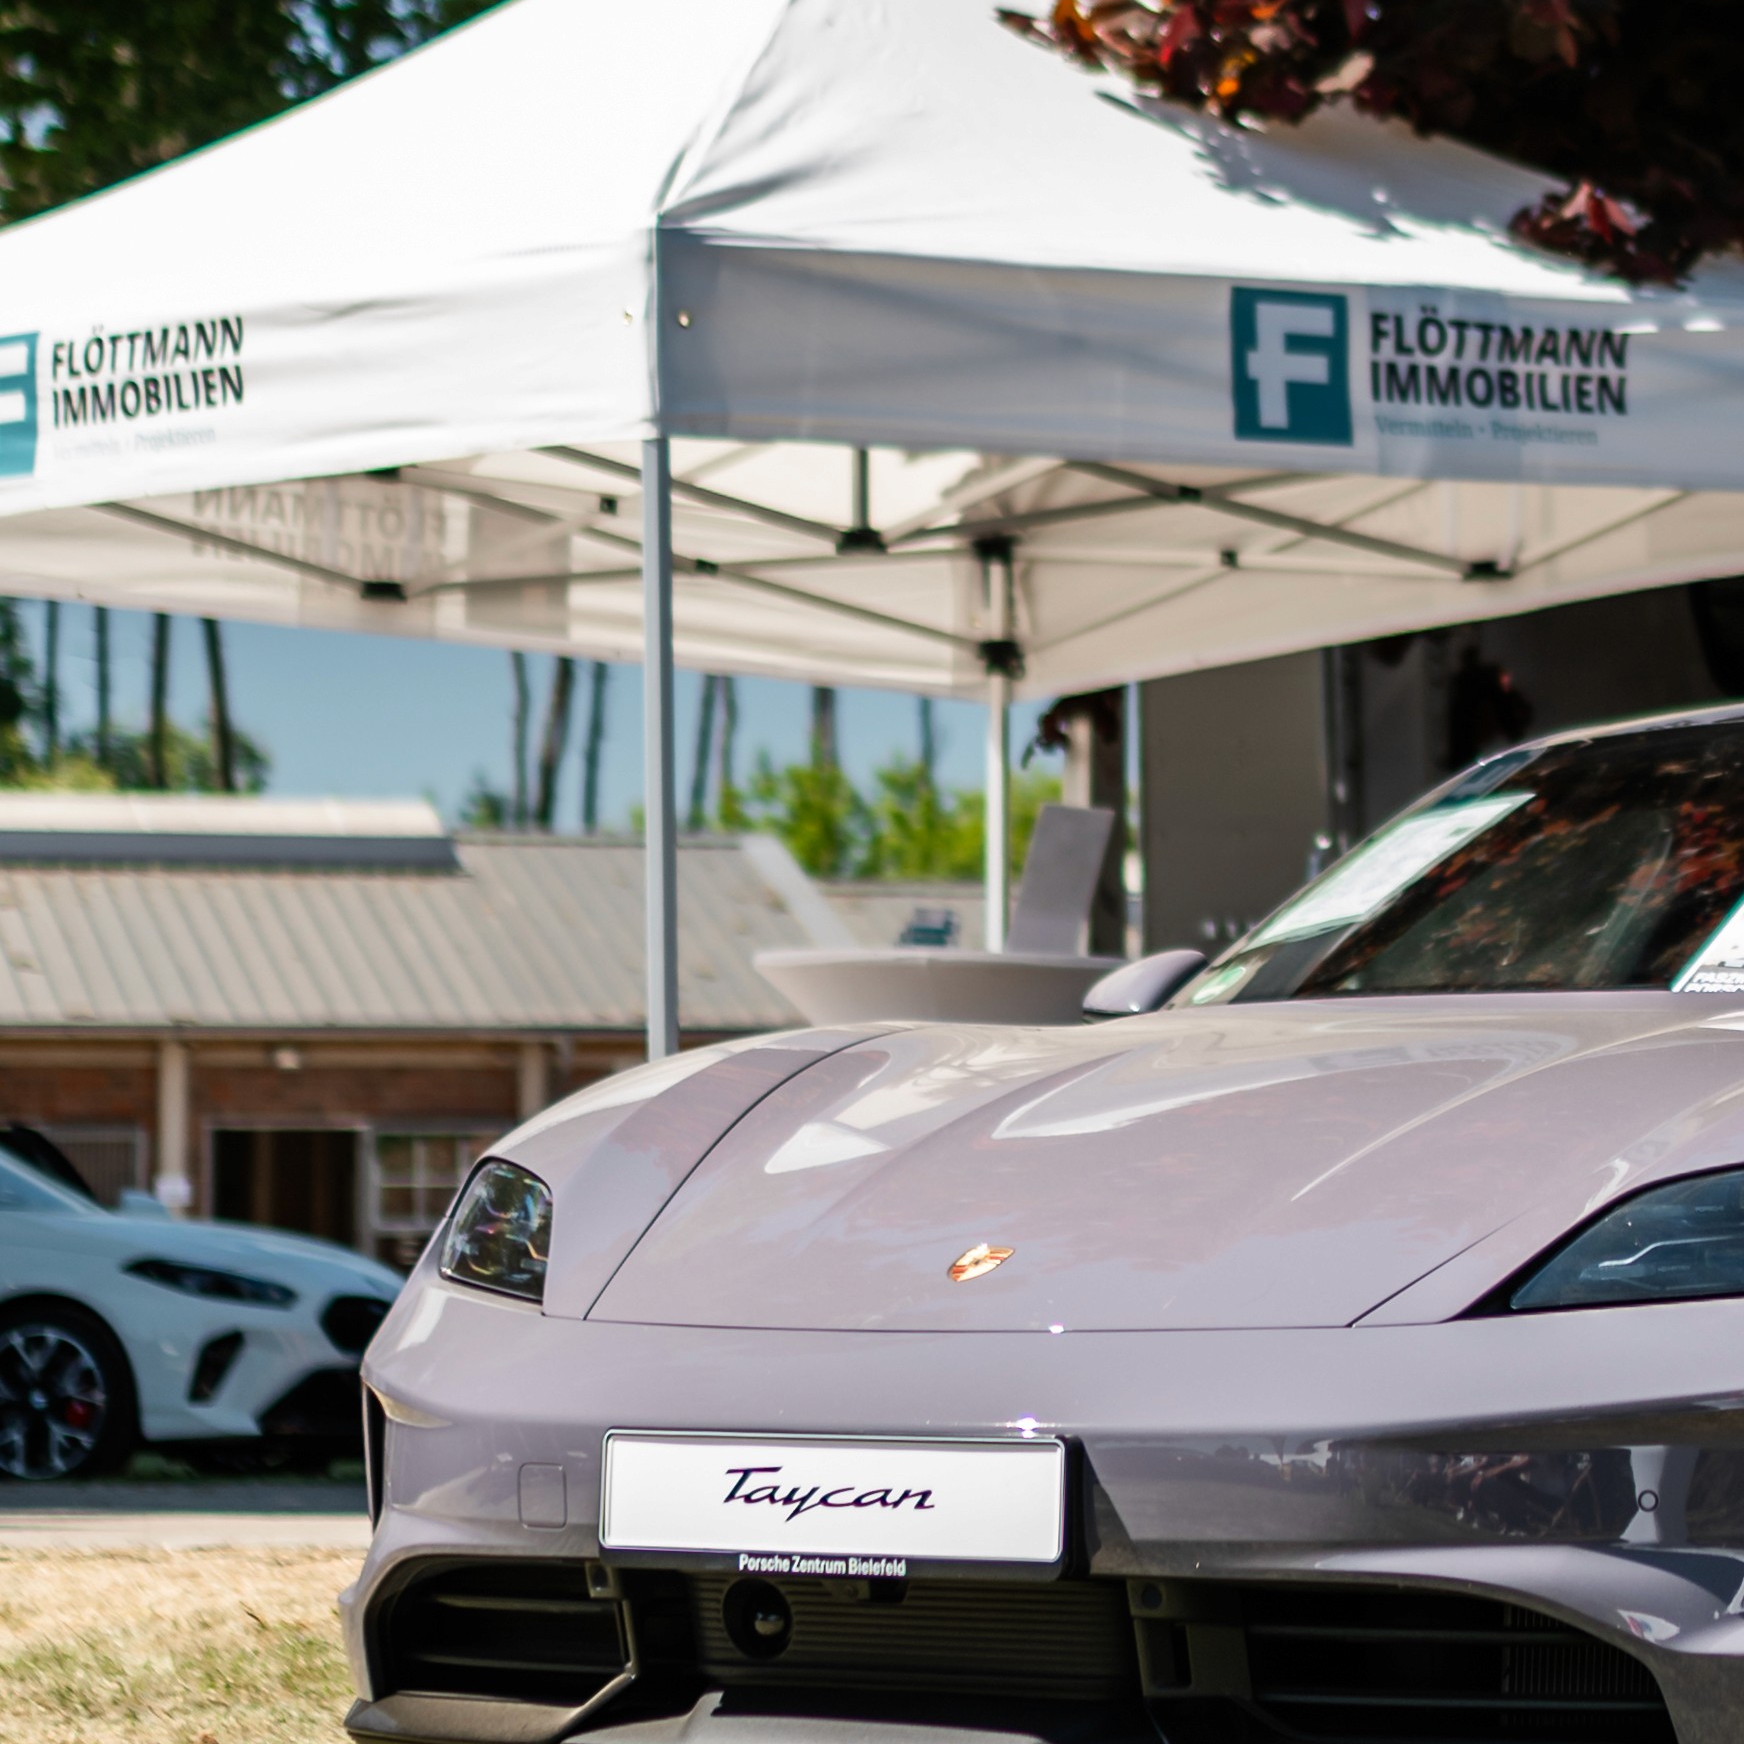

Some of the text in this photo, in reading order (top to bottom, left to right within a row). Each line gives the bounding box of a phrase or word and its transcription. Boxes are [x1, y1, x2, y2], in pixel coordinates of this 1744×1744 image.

[52, 315, 243, 381] FLÖTTMANN
[1371, 305, 1629, 369] FLÖTTMANN
[53, 365, 243, 430] IMMOBILIEN
[1371, 361, 1628, 415] IMMOBILIEN
[723, 1465, 936, 1523] Taycan
[738, 1553, 906, 1577] Porsche Zentrum Bielefeld
